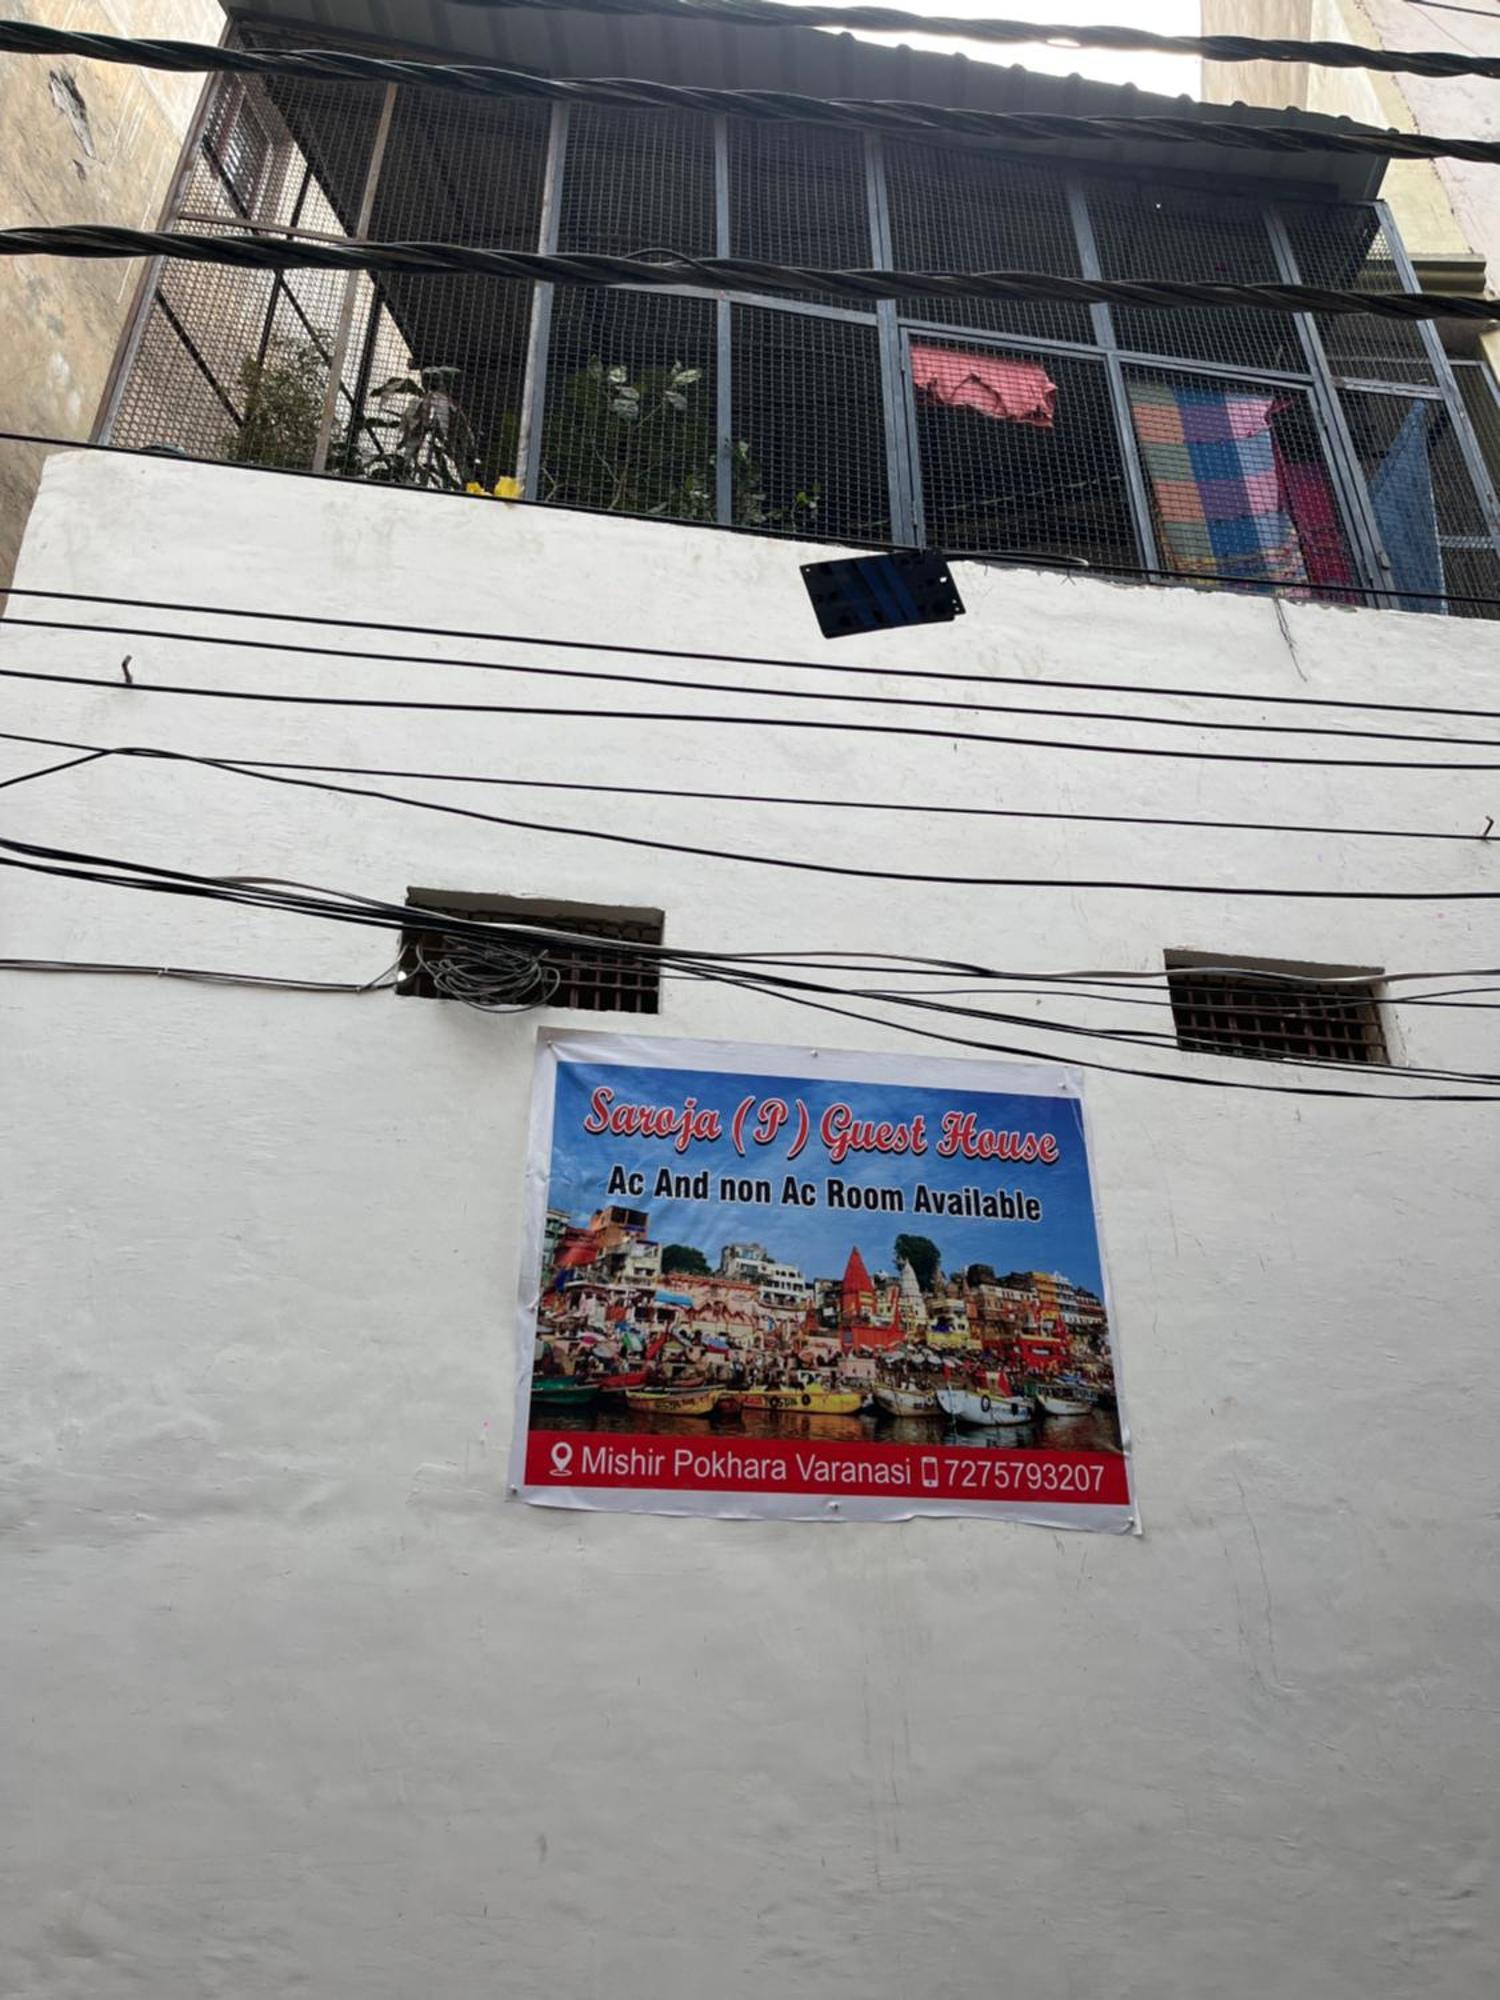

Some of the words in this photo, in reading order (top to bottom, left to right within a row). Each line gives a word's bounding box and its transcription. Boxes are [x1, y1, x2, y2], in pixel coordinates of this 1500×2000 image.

[584, 1086, 721, 1153] Saroja
[820, 1102, 928, 1163] Guest
[937, 1111, 1060, 1163] House
[607, 1165, 644, 1195] Ac
[654, 1168, 709, 1199] And
[720, 1178, 771, 1203] non
[781, 1176, 816, 1206] Ac
[827, 1179, 904, 1212] Room
[914, 1184, 1041, 1221] Available
[580, 1445, 666, 1476] Mishir
[673, 1448, 787, 1480] Pokhara
[795, 1453, 912, 1484] Varanasi
[944, 1459, 1105, 1492] 7275793207
